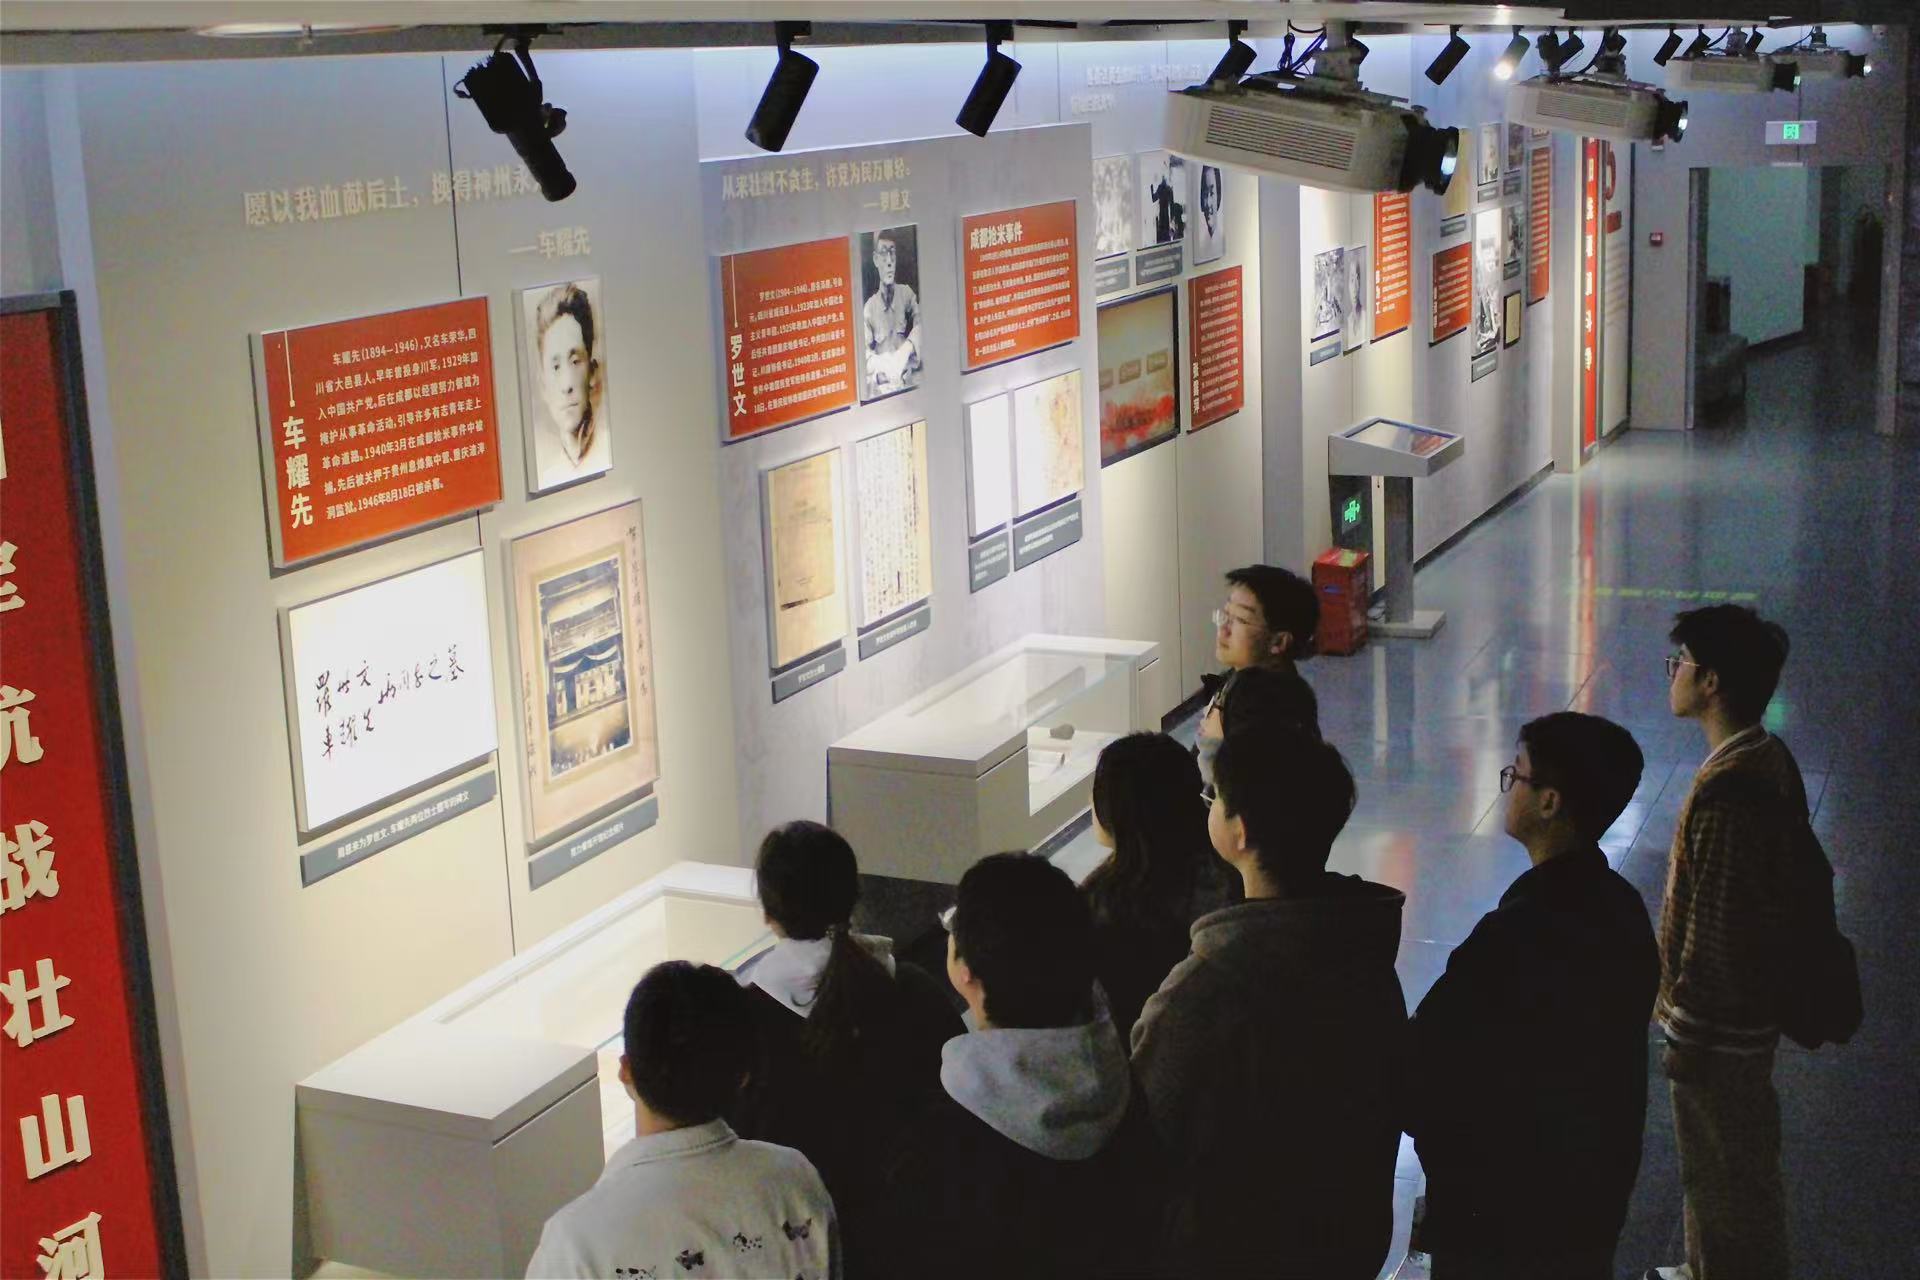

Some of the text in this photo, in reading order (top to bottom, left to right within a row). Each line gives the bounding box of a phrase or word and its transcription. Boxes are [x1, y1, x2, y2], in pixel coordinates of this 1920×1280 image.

[244, 164, 541, 225] 愿以我血献后土，换得神州永
[730, 333, 748, 417] 罗世文
[282, 415, 314, 529] 车耀先
